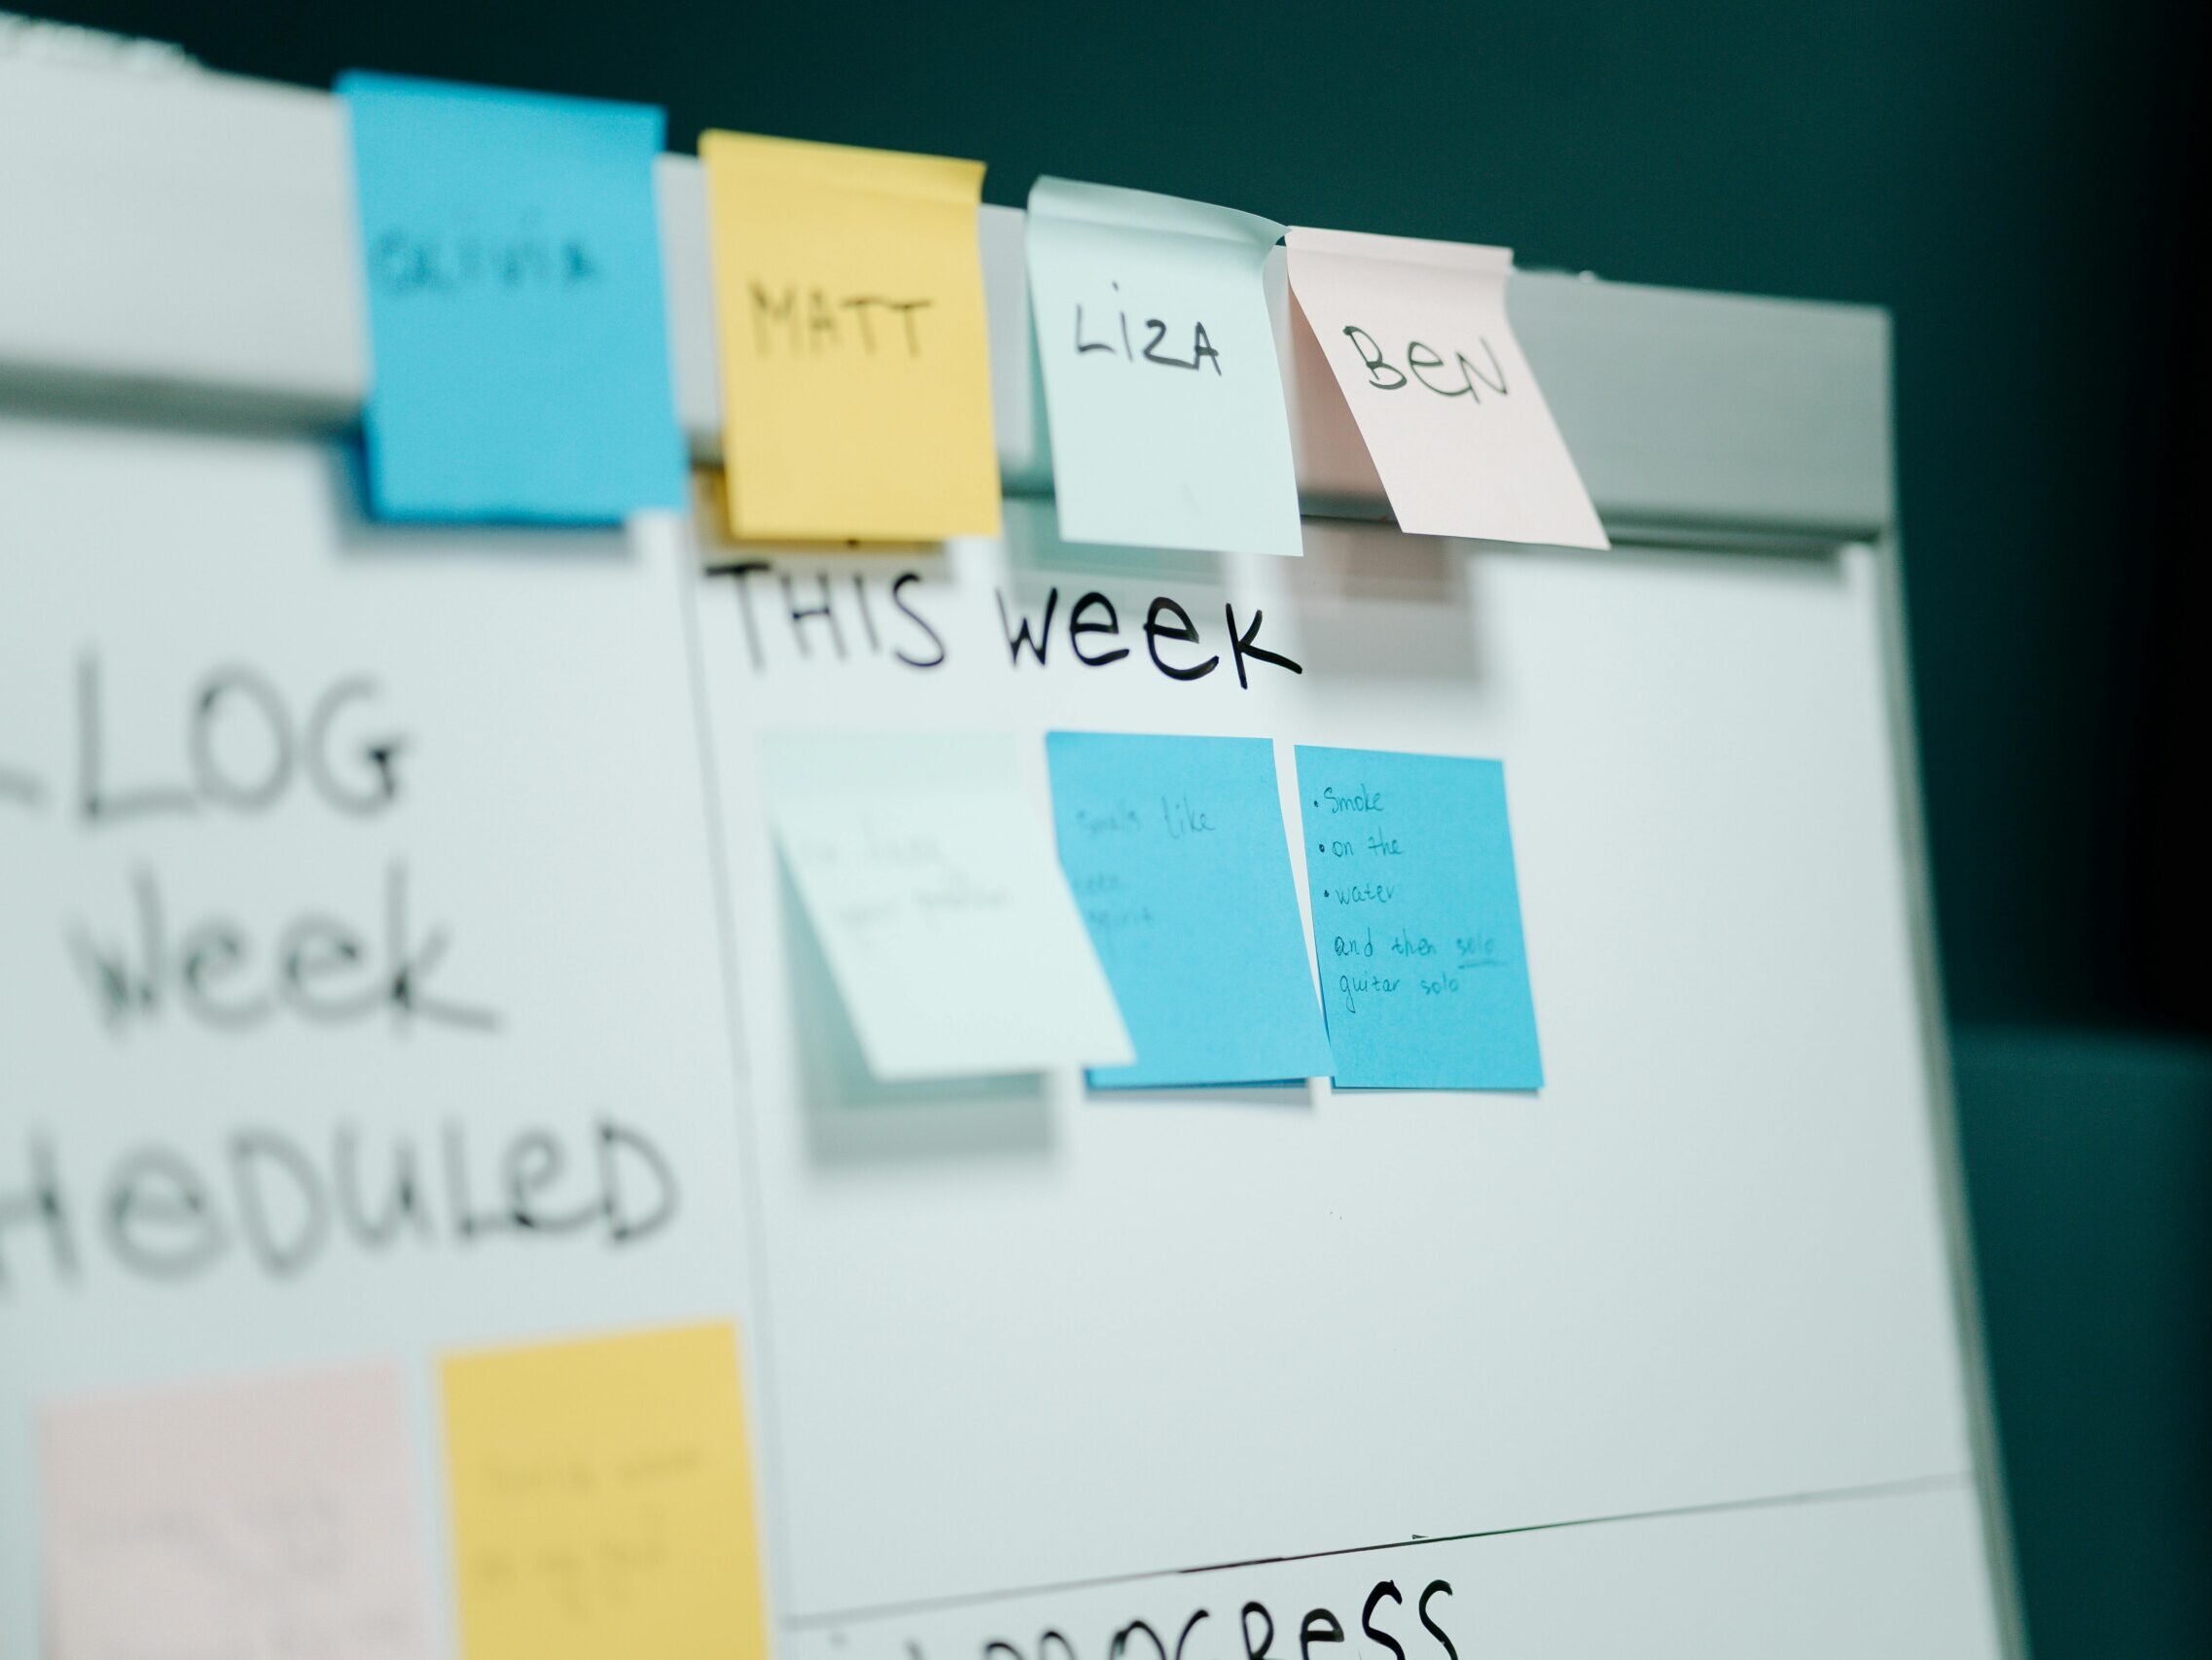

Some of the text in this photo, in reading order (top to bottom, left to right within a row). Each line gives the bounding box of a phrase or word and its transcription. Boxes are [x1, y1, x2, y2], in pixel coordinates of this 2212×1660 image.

[748, 278, 933, 359] MATT
[704, 560, 945, 673] THIS
[0, 644, 416, 829] LOG
[1161, 795, 1216, 839] like
[1332, 828, 1404, 857] on the
[1335, 883, 1395, 904] water
[1334, 926, 1374, 957] and
[1391, 929, 1437, 957] then
[1339, 971, 1459, 1013] guitar solo
